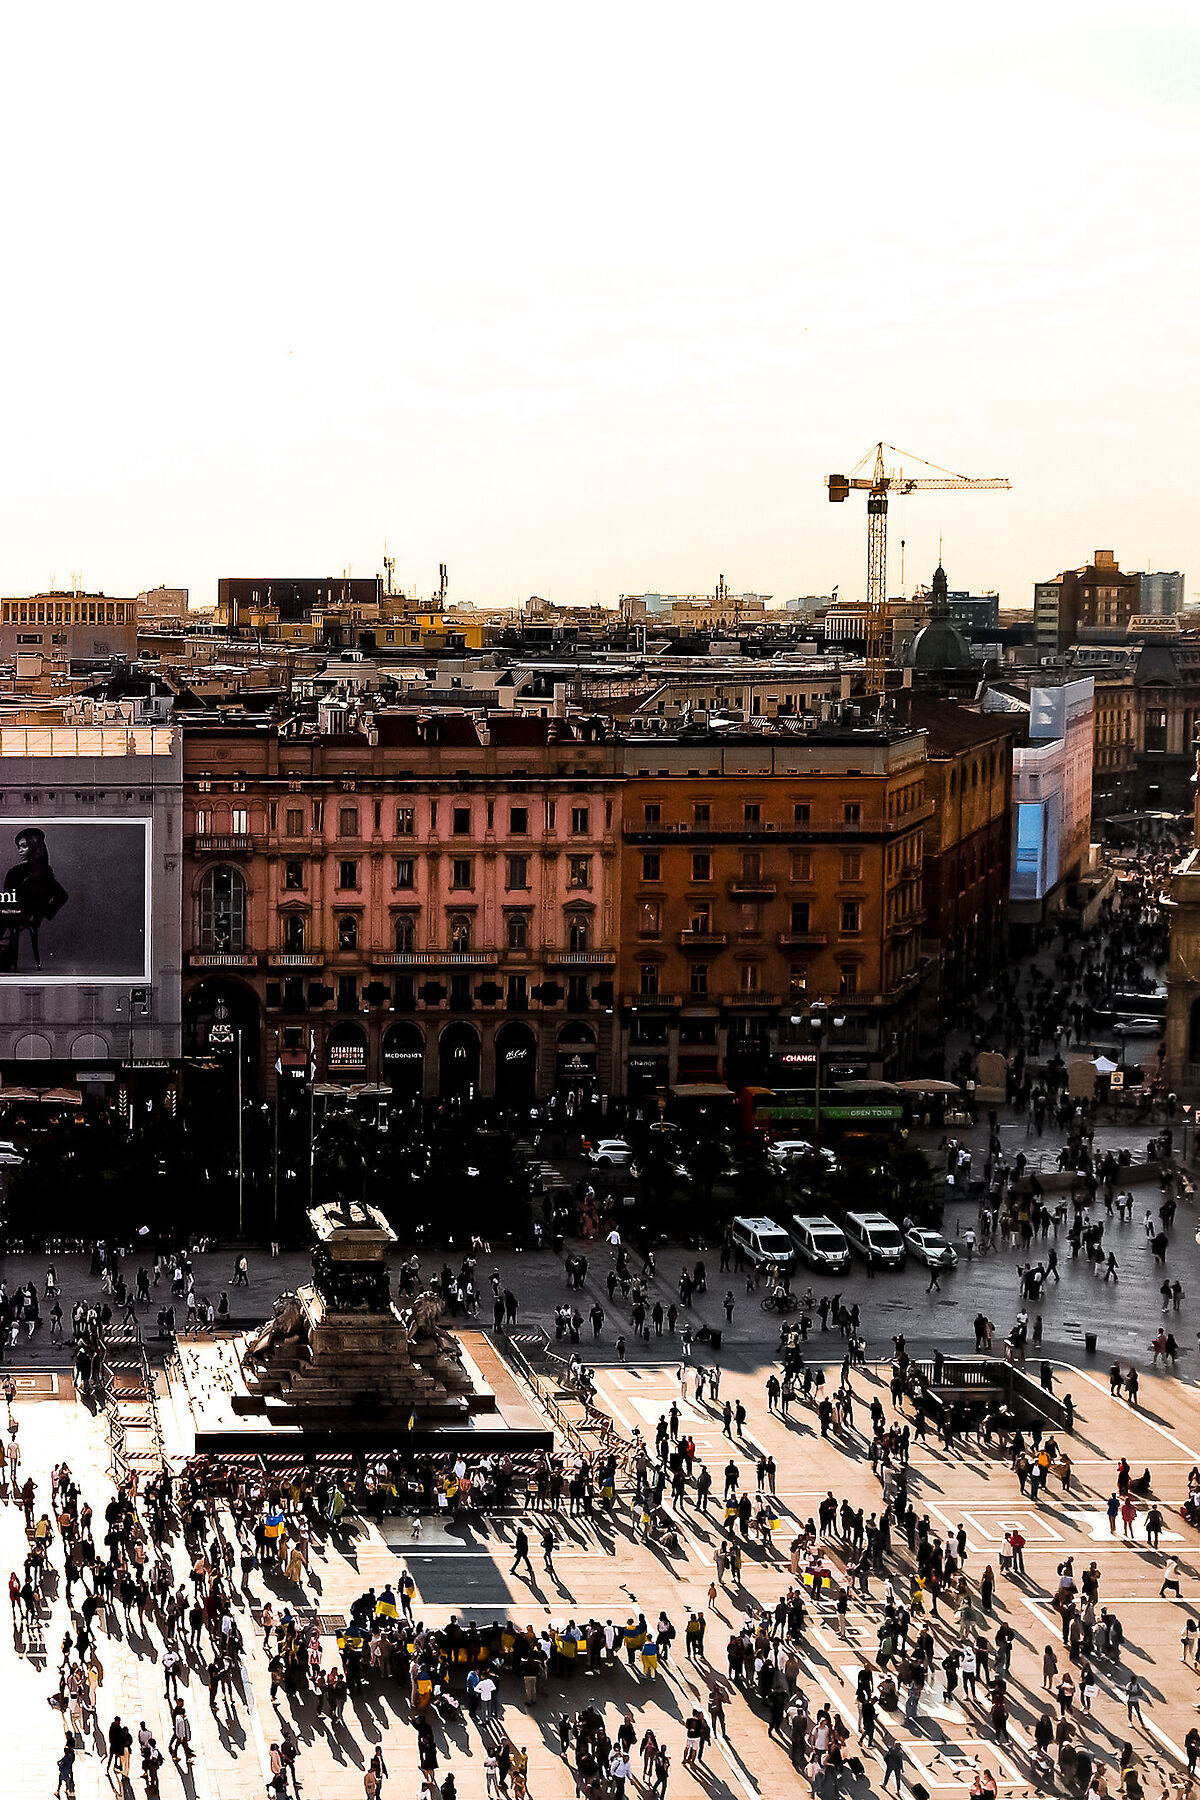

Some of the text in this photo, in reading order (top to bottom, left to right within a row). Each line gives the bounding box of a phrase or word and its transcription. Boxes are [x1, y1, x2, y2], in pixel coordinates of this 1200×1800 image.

[212, 1024, 231, 1032] KFC
[291, 1070, 305, 1078] TIM
[850, 1109, 871, 1117] OPEN
[872, 1109, 893, 1117] TOUR
